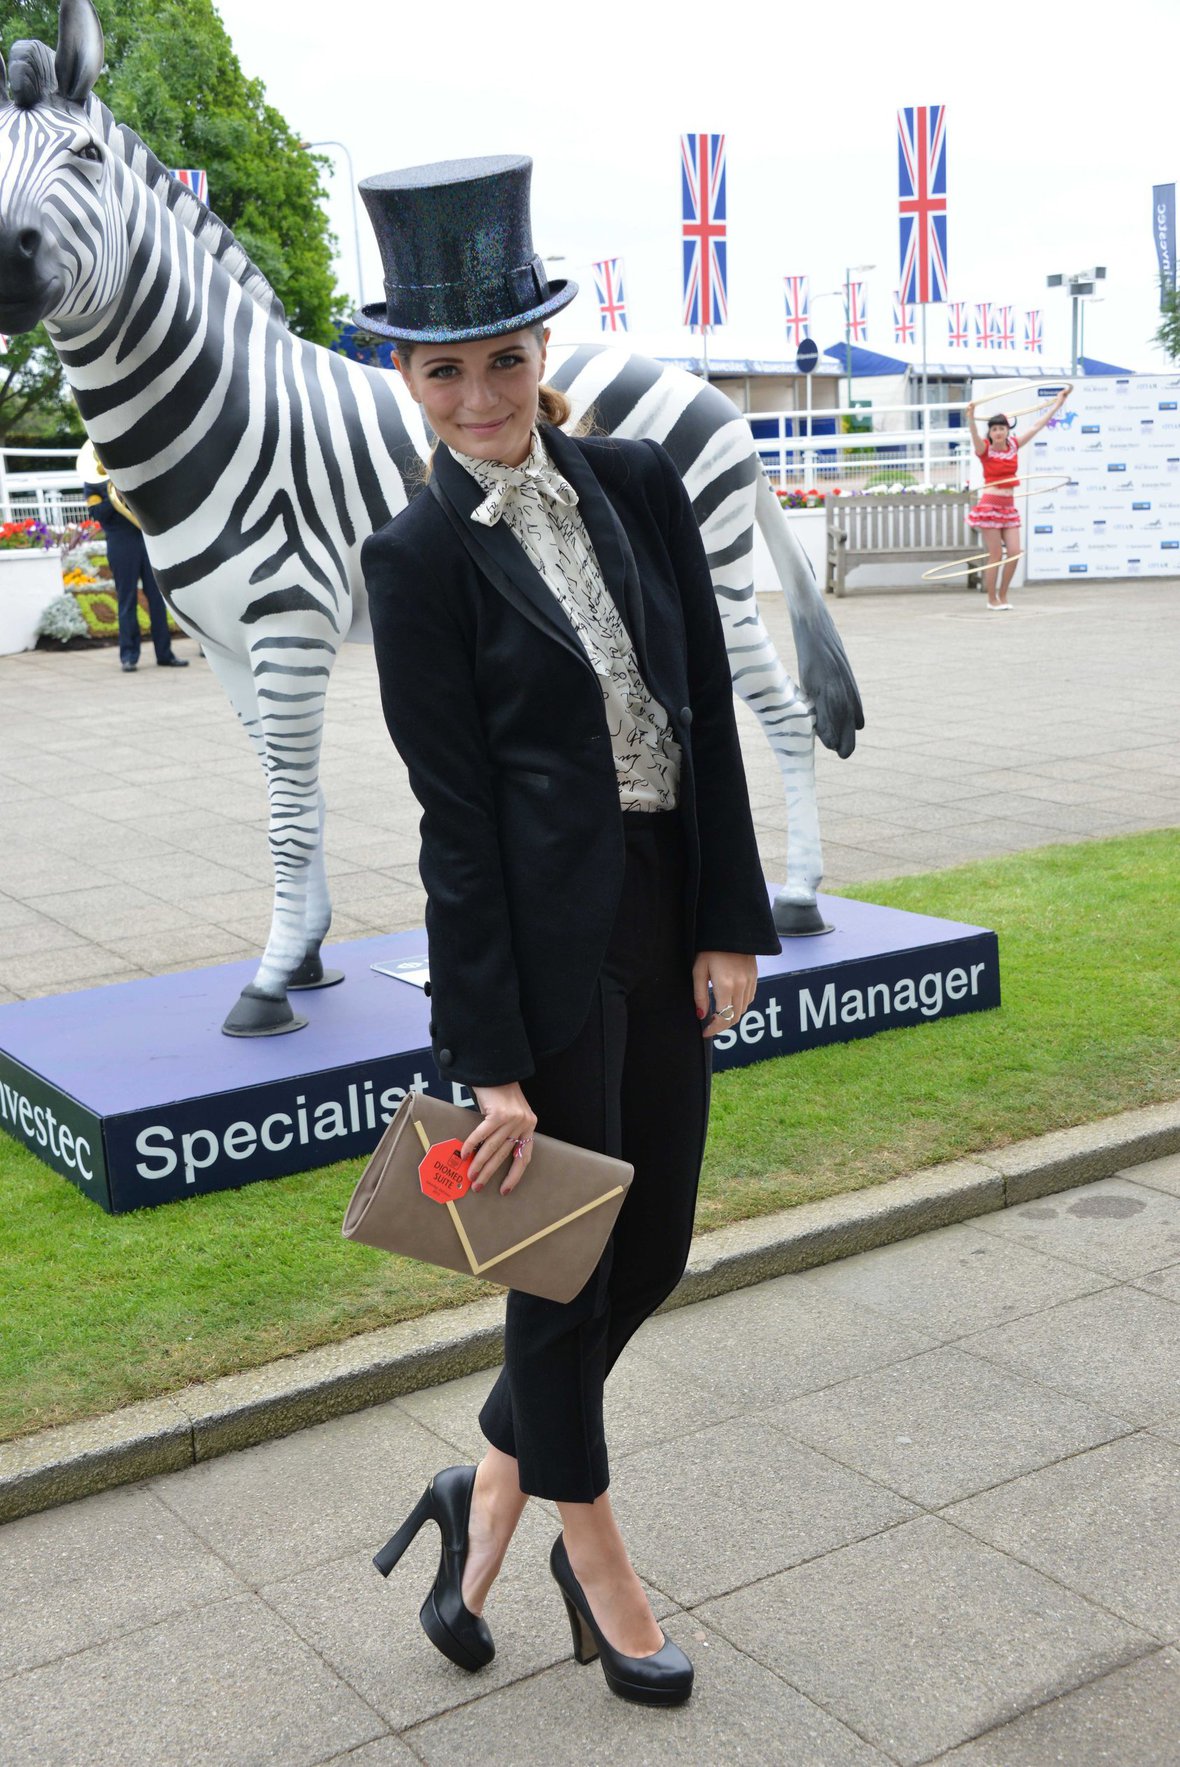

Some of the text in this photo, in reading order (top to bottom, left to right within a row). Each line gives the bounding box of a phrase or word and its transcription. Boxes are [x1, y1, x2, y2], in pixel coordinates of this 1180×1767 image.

[135, 962, 985, 1184] Specialist set Manager
[433, 1172, 454, 1189] SUITE
[434, 1160, 463, 1183] DIOMED
